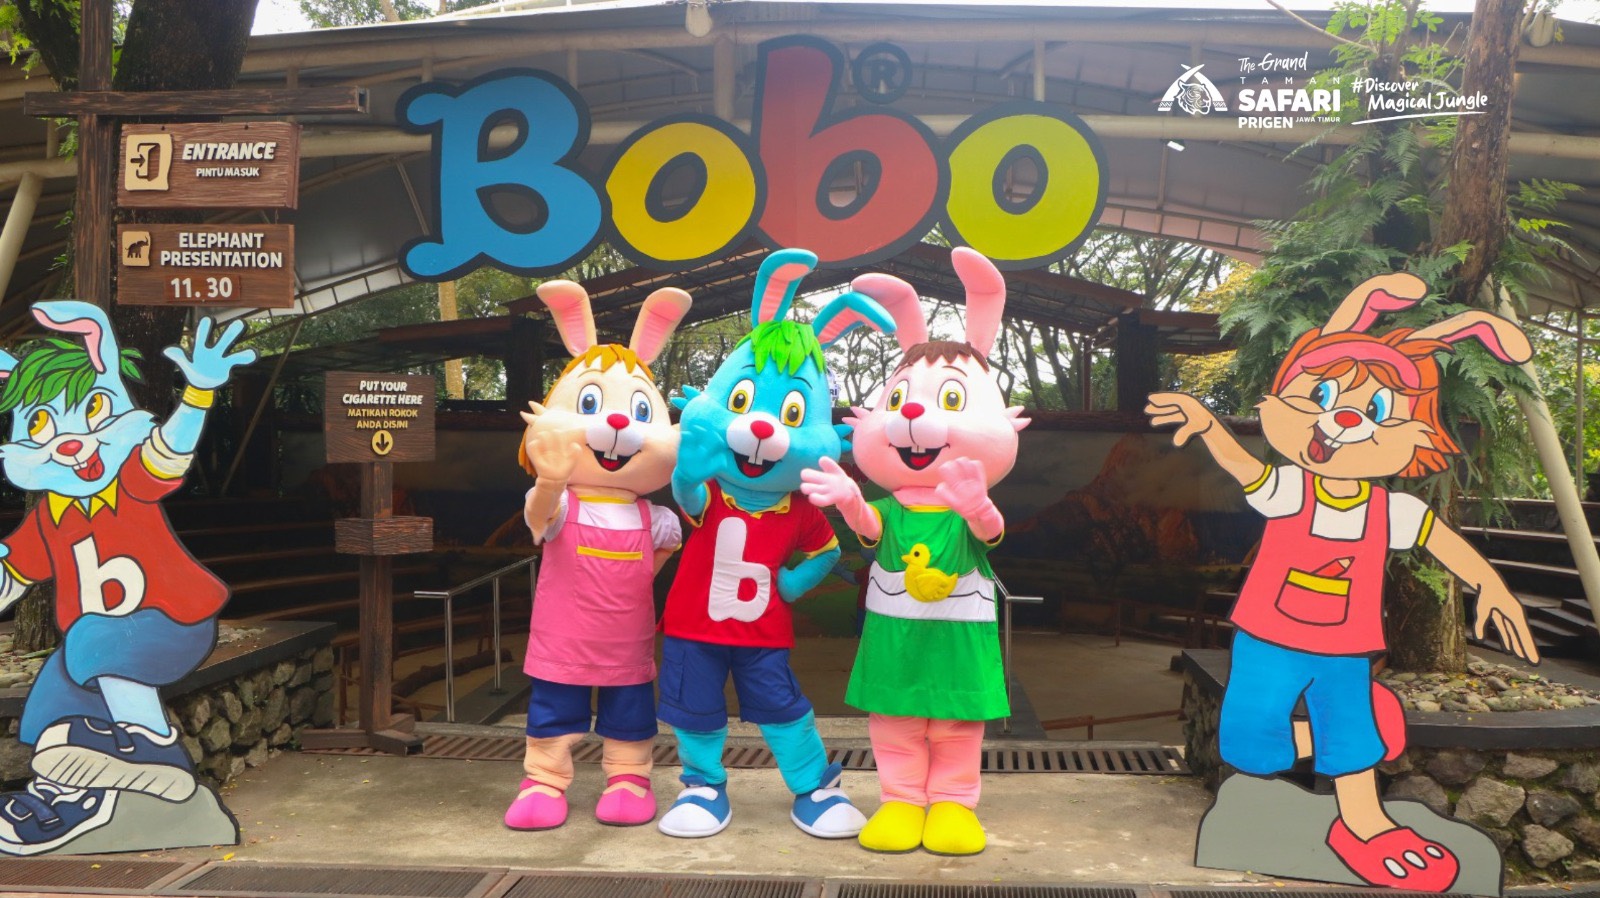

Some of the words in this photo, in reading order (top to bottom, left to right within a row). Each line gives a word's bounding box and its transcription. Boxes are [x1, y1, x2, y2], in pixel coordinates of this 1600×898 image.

[182, 141, 276, 160] ENTRANCE
[397, 34, 1109, 283] Bobo
[196, 168, 223, 177] PINTU
[224, 167, 260, 177] MASUK
[178, 232, 264, 248] ELEPHANT
[160, 250, 282, 268] PRESENTATION
[360, 380, 380, 391] PUT
[380, 381, 408, 392] YOUR
[342, 393, 396, 405] CIGARETTE
[397, 394, 423, 405] HERE
[347, 408, 388, 417] MATIKAN
[389, 408, 418, 418] ROKOK
[356, 420, 382, 429] ANDA
[383, 420, 408, 429] DISINI
[72, 532, 147, 617] b
[708, 516, 771, 623] b
